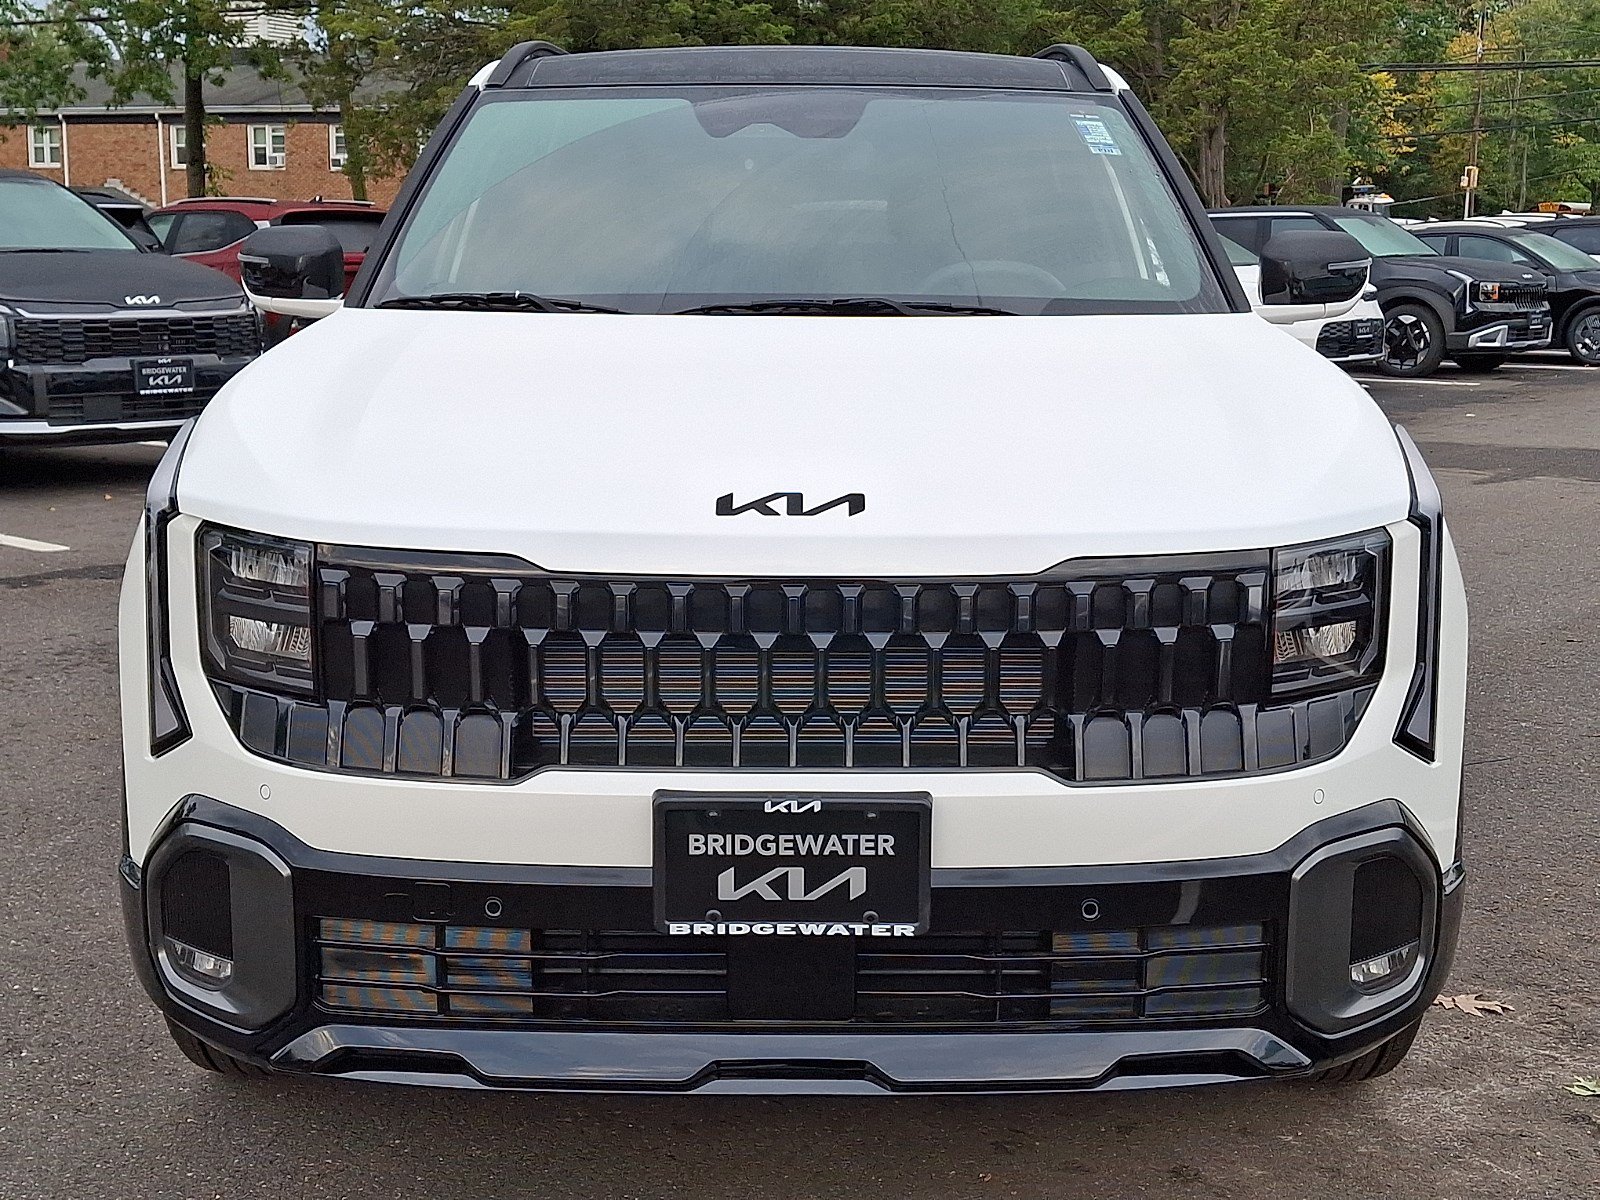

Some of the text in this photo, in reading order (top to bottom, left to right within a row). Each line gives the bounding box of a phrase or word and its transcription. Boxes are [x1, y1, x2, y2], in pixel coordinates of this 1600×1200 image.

[124, 295, 160, 304] KIA
[142, 366, 186, 375] BRIDGEWATER
[149, 374, 181, 386] KIA
[716, 492, 865, 517] KIA
[764, 799, 821, 813] KIA
[688, 834, 895, 856] BRIDGEWATER
[717, 866, 867, 901] KIA
[669, 923, 915, 937] BRIDGEWATER
